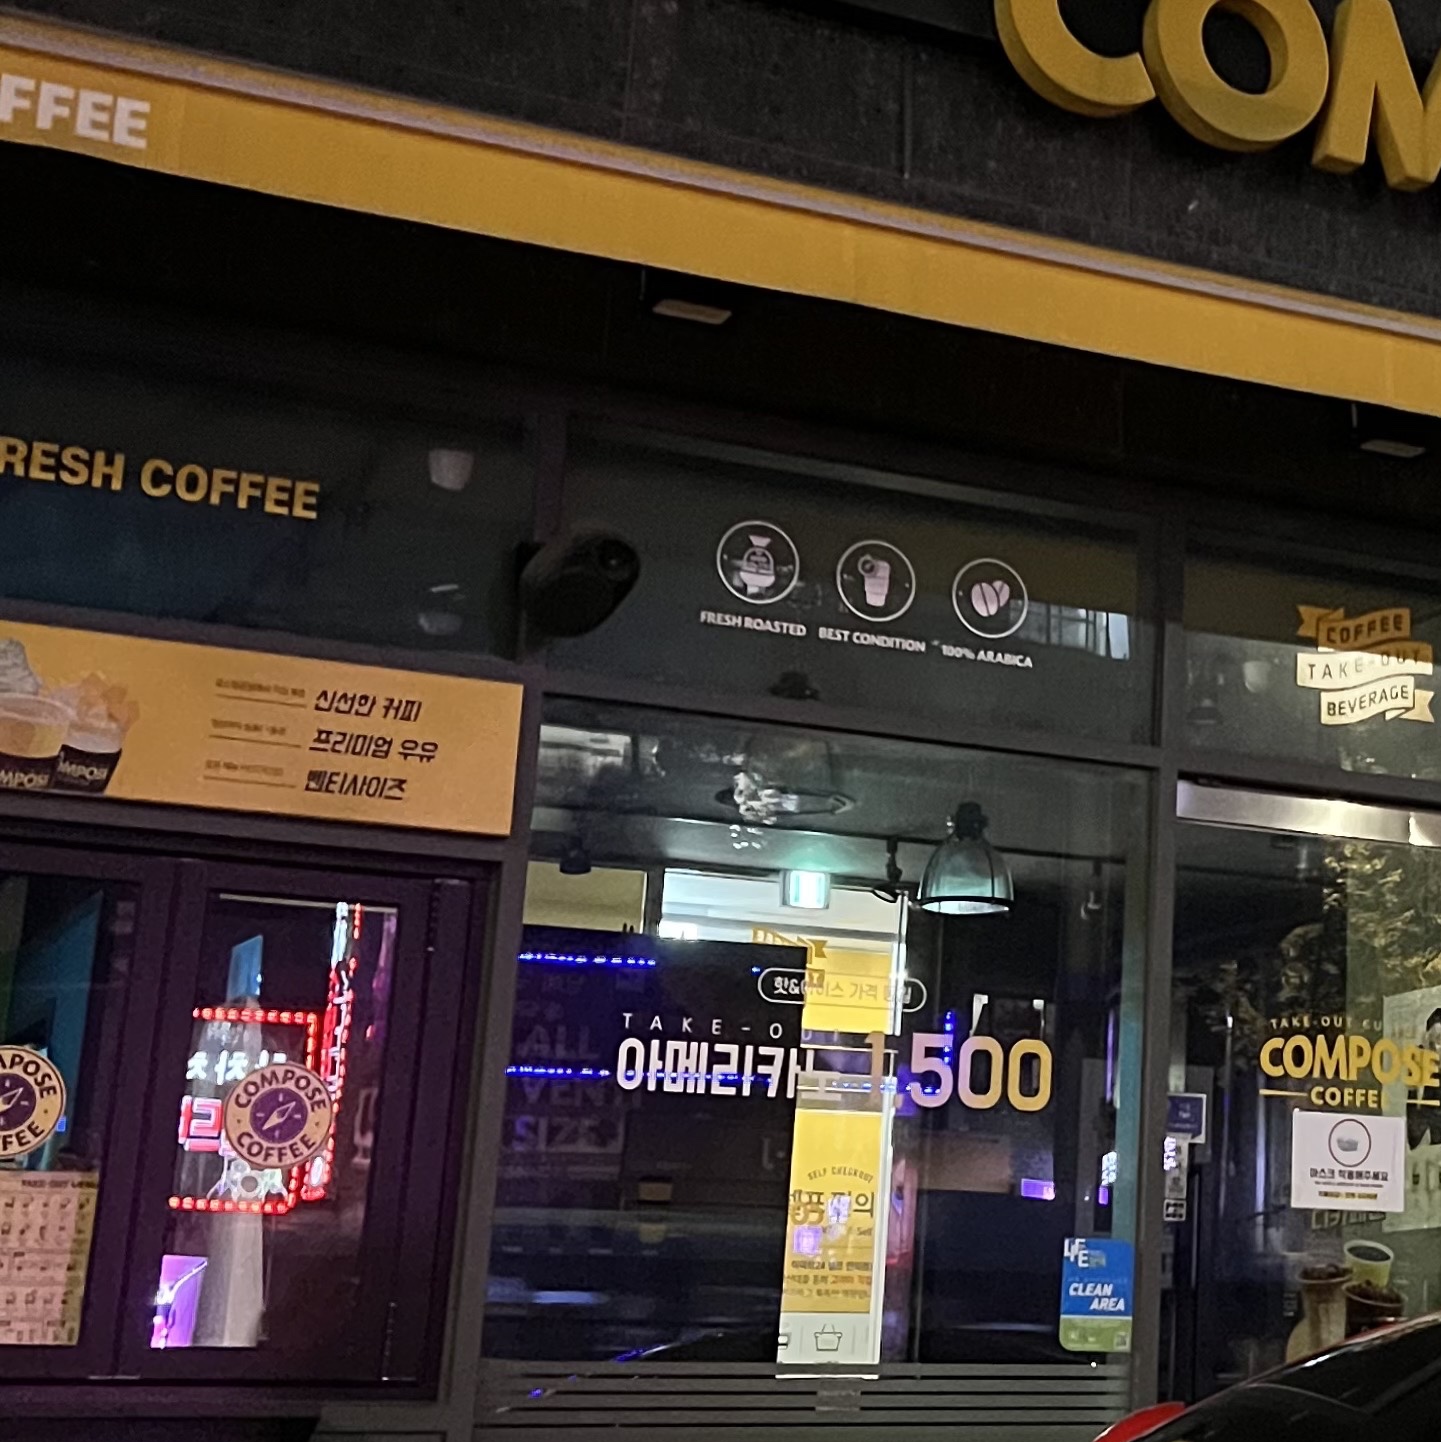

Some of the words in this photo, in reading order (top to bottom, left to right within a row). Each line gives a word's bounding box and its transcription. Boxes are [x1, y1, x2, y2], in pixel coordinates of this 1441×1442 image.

[0, 73, 151, 149] FFEE
[140, 458, 320, 520] COFFEE
[700, 610, 742, 628] FRESH
[743, 617, 807, 637] ROASTED
[818, 626, 849, 643] BEST
[852, 631, 925, 653] CONDITION
[1327, 612, 1404, 644] COFFEE
[976, 650, 1033, 669] ARABICA
[382, 697, 423, 722] 커피
[1327, 685, 1410, 717] BEVERAGE
[309, 728, 394, 760] 프리미엄
[397, 739, 439, 763] 우유
[616, 1037, 843, 1101] 아메리카노
[1260, 1034, 1441, 1087] COMPOSE
[234, 1070, 327, 1113] COMPOSE
[236, 1131, 316, 1163] COFFEE
[1069, 1283, 1113, 1297] CLEAN
[1090, 1298, 1125, 1312] AREA
